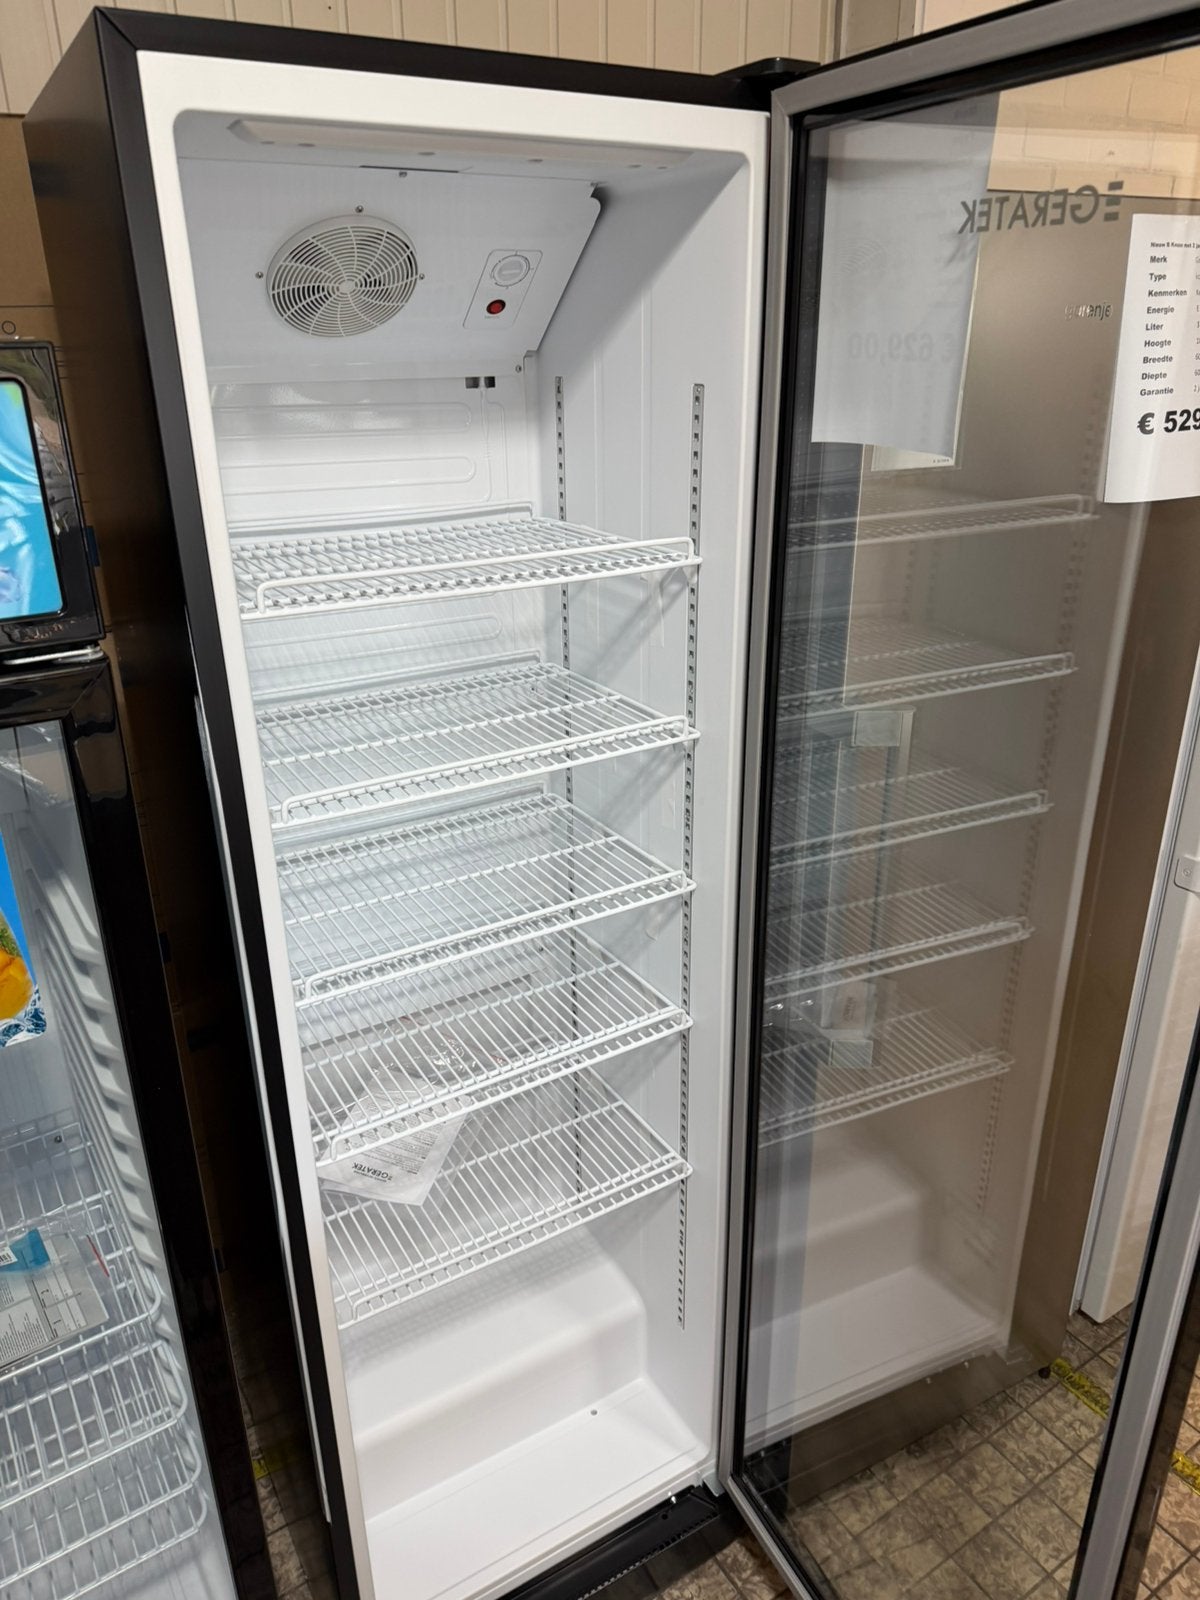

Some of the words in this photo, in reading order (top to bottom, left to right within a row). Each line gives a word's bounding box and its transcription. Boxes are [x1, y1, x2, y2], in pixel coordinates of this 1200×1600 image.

[1149, 272, 1167, 282] Type
[1148, 289, 1187, 297] Kenmerken
[1147, 305, 1175, 315] Energie
[1145, 323, 1164, 331] Liter
[1144, 339, 1172, 348] Hoogte
[1142, 355, 1173, 364] Breedte
[1141, 371, 1168, 380] Diepte
[1140, 387, 1174, 396] Garantie
[1137, 412, 1155, 435] €
[1163, 408, 1200, 433] 529
[352, 1162, 389, 1179] GERATEK
